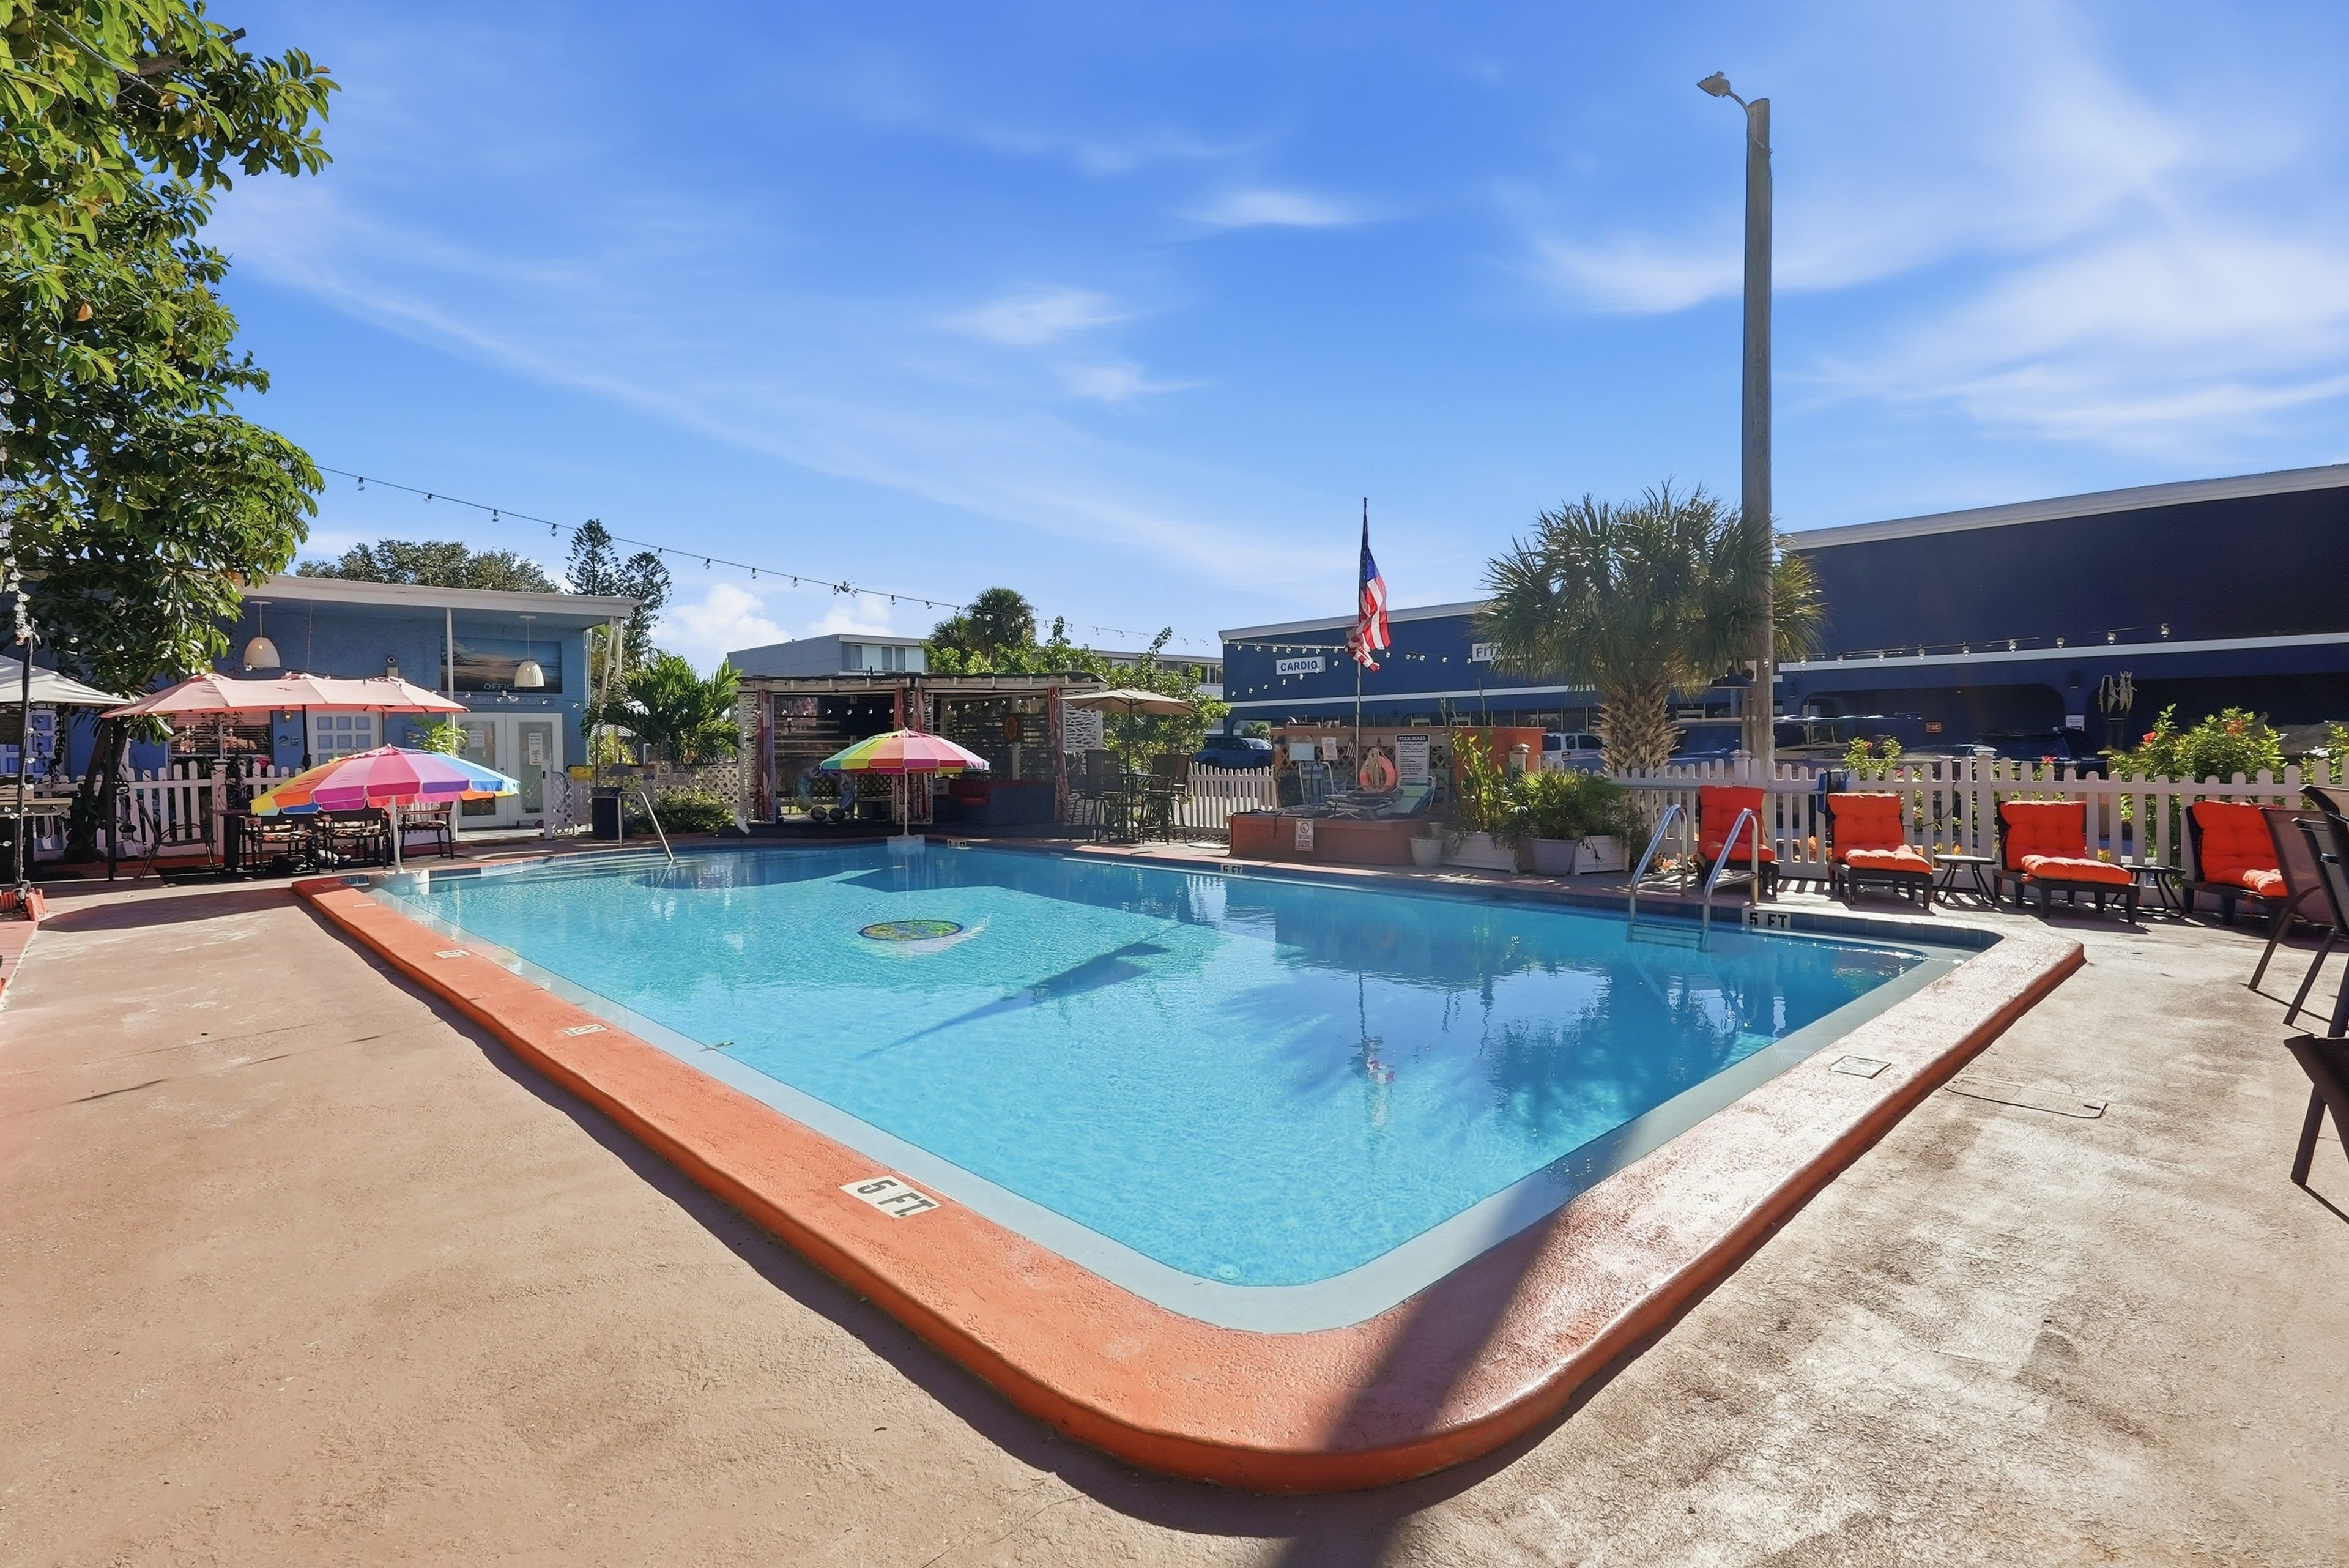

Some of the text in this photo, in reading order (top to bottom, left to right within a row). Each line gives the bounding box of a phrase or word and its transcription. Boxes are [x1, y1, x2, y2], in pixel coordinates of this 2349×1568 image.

[1280, 660, 1318, 671] CARDIO
[1749, 912, 1787, 927] 5 FT
